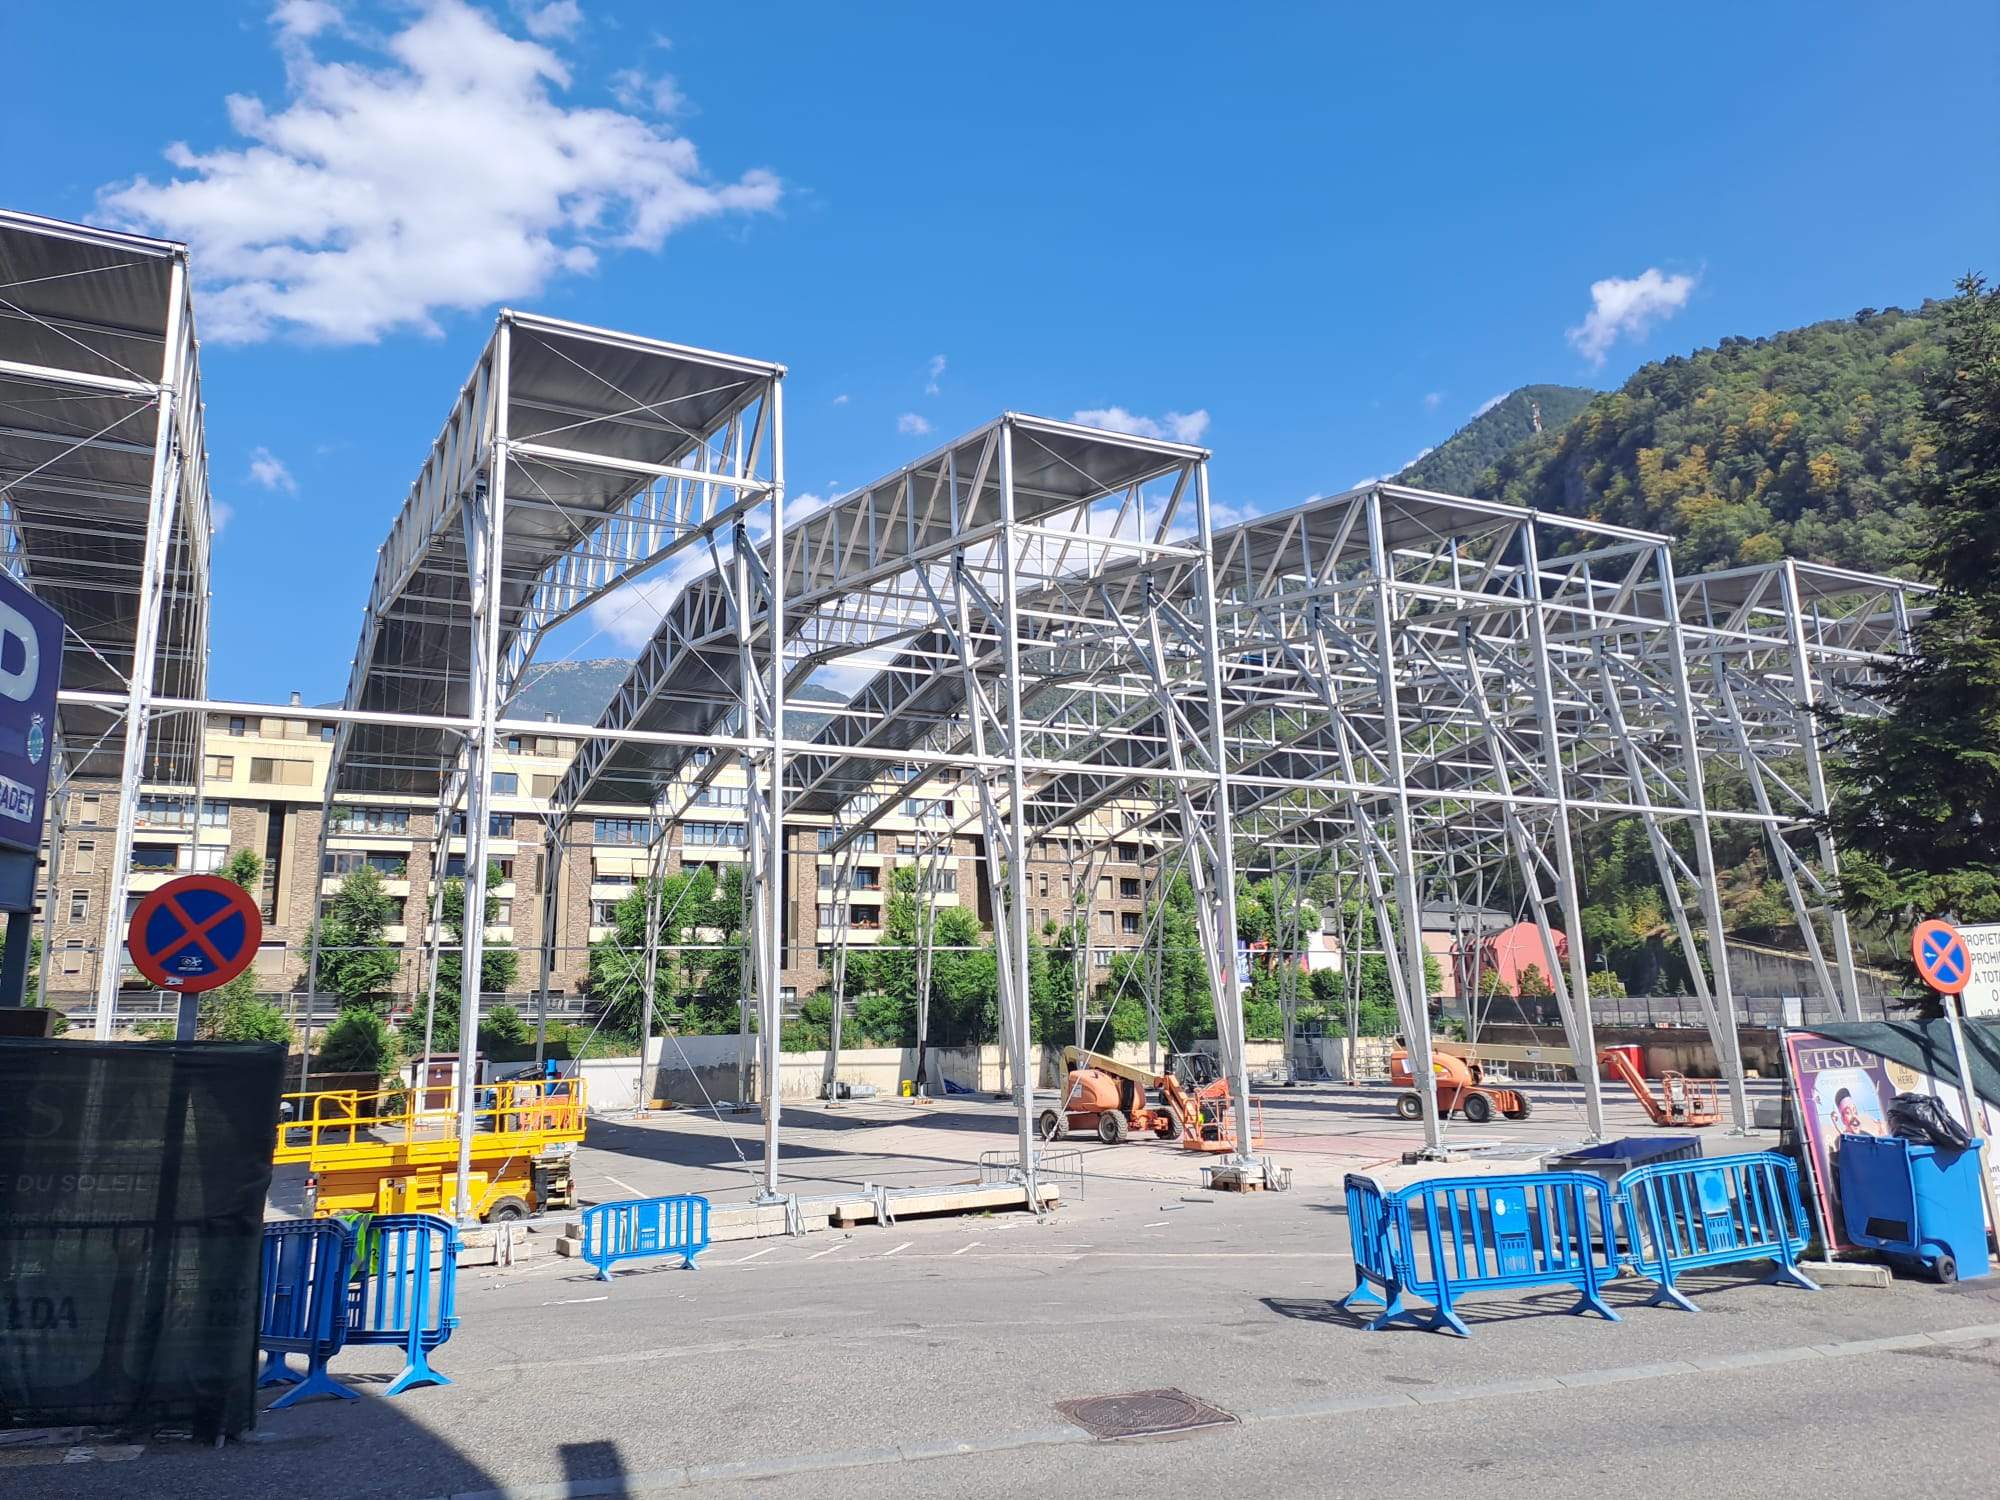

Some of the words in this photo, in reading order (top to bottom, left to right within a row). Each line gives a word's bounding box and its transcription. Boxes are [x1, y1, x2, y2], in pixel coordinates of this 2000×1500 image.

[0, 782, 33, 816] ADET
[1960, 932, 2000, 946] PROPIET
[1970, 951, 2000, 965] PROHI
[1981, 969, 2000, 984] TOT
[1814, 1049, 1864, 1069] FESTA
[61, 1174, 152, 1192] SOLEIL
